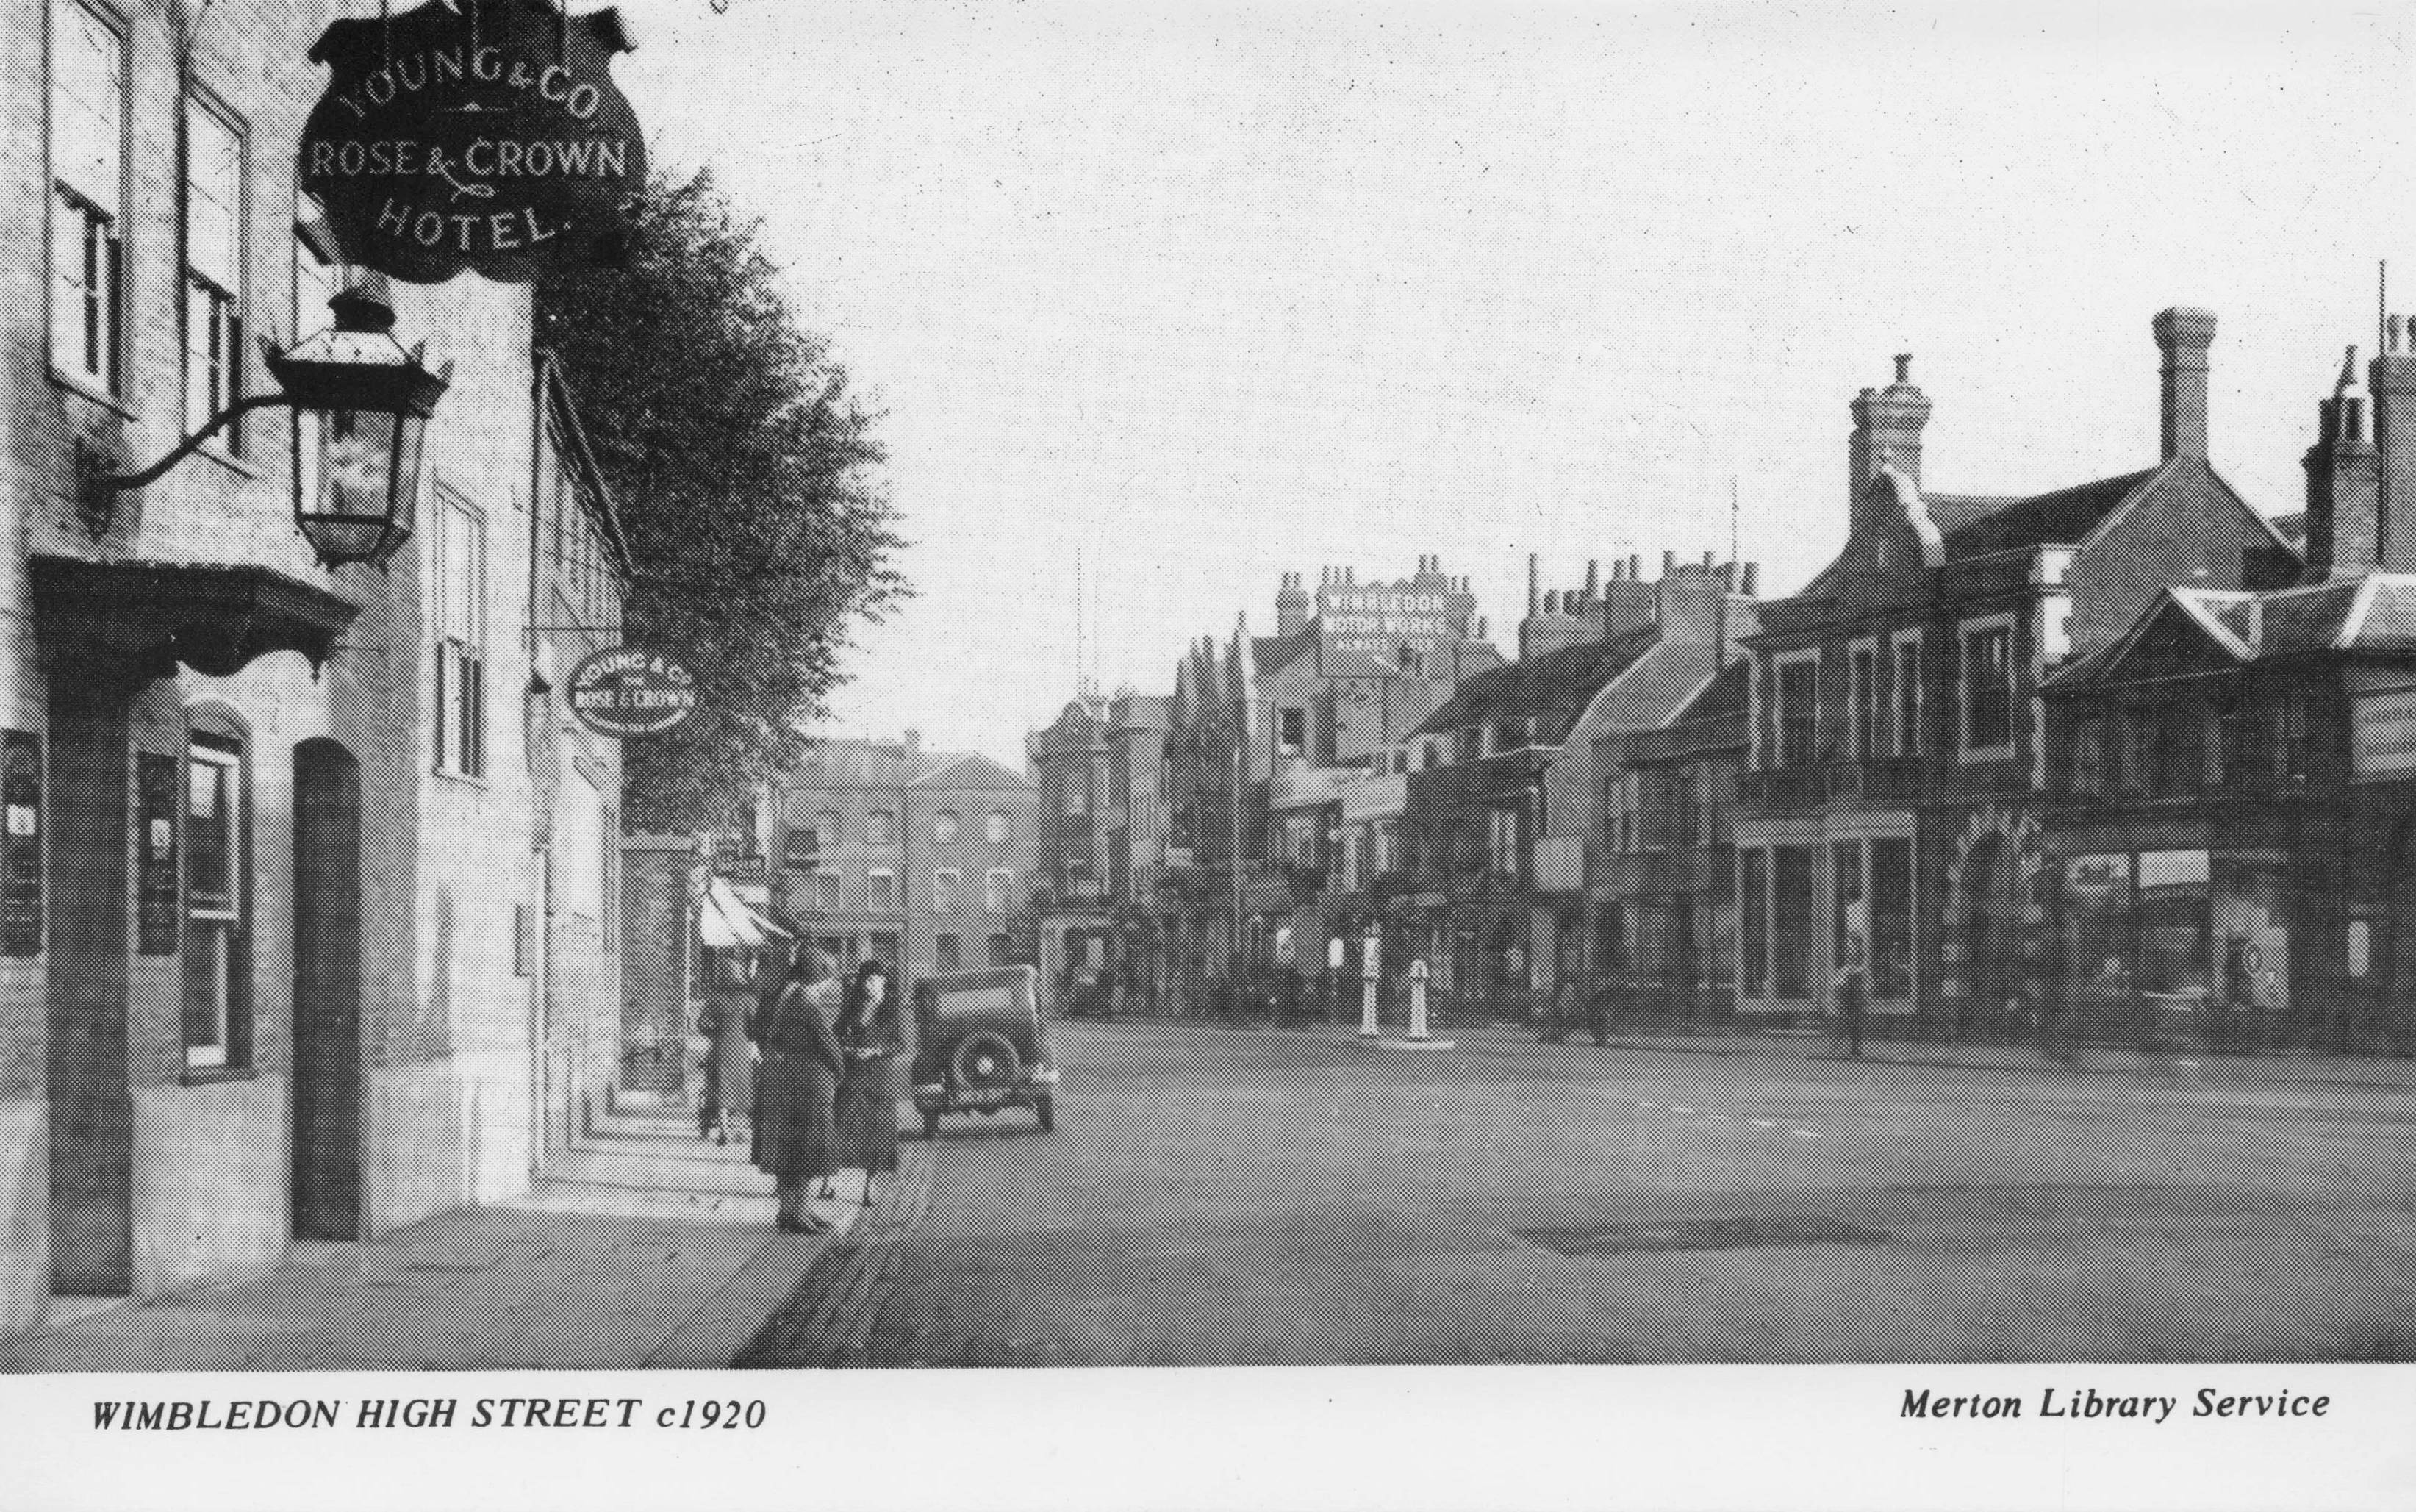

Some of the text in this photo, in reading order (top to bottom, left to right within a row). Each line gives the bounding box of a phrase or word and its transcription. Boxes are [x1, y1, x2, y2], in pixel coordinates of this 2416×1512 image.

[337, 46, 502, 118] YOUNG
[507, 62, 535, 90] &
[311, 137, 627, 203] ROSE & CROWN
[1327, 593, 1444, 612] WIMBLEDON
[1322, 615, 1447, 634] MOTOR WORKS
[575, 652, 646, 687] YOUNG
[650, 657, 664, 674] &
[575, 689, 695, 708] ROSE & CROWN
